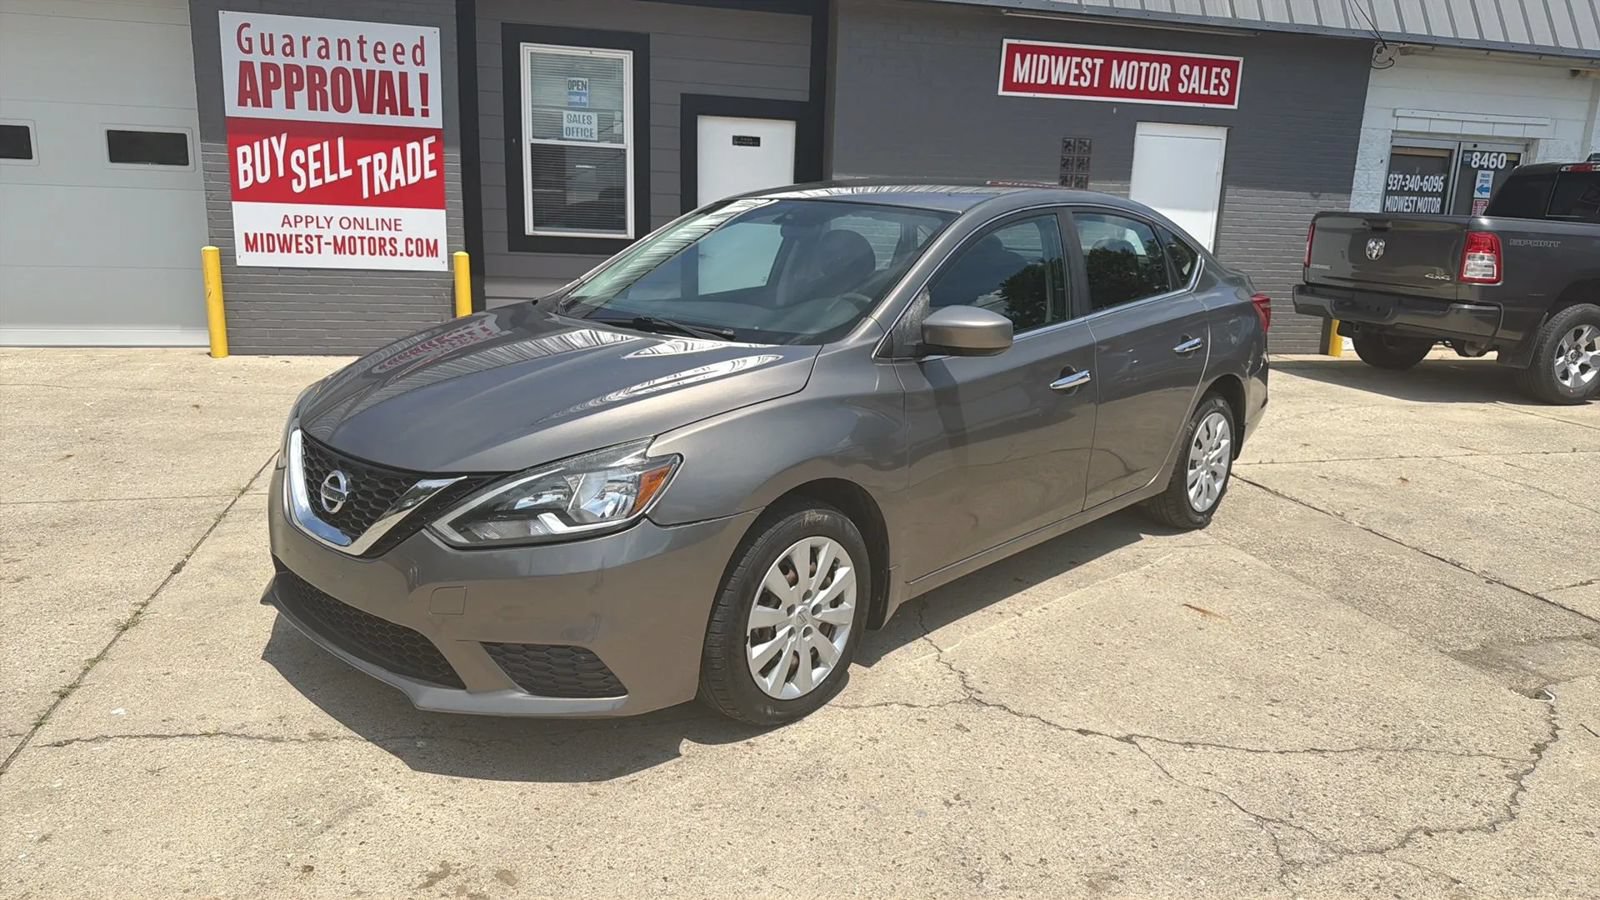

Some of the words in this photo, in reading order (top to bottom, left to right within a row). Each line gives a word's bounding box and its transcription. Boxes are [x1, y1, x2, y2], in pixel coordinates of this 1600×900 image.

[236, 22, 426, 67] Guaranteed
[1012, 53, 1104, 87] MIDWEST
[1110, 59, 1172, 92] MOTOR
[1178, 64, 1231, 97] SALES
[237, 61, 430, 118] APPROVAL!
[568, 80, 587, 91] OPEN
[567, 113, 592, 125] SALES
[565, 127, 594, 138] OFFICE
[236, 132, 288, 190] BUY
[290, 136, 353, 194] SELL
[357, 135, 437, 200] TRADE
[1470, 151, 1507, 169] 8460
[1387, 174, 1444, 193] 937-340-6096
[1384, 195, 1416, 213] MIDWEST
[1416, 197, 1441, 214] MOTOR
[281, 214, 334, 229] APPLY
[339, 216, 403, 232] ONLINE
[244, 232, 439, 258] MIDWEST-MOTORS.COM
